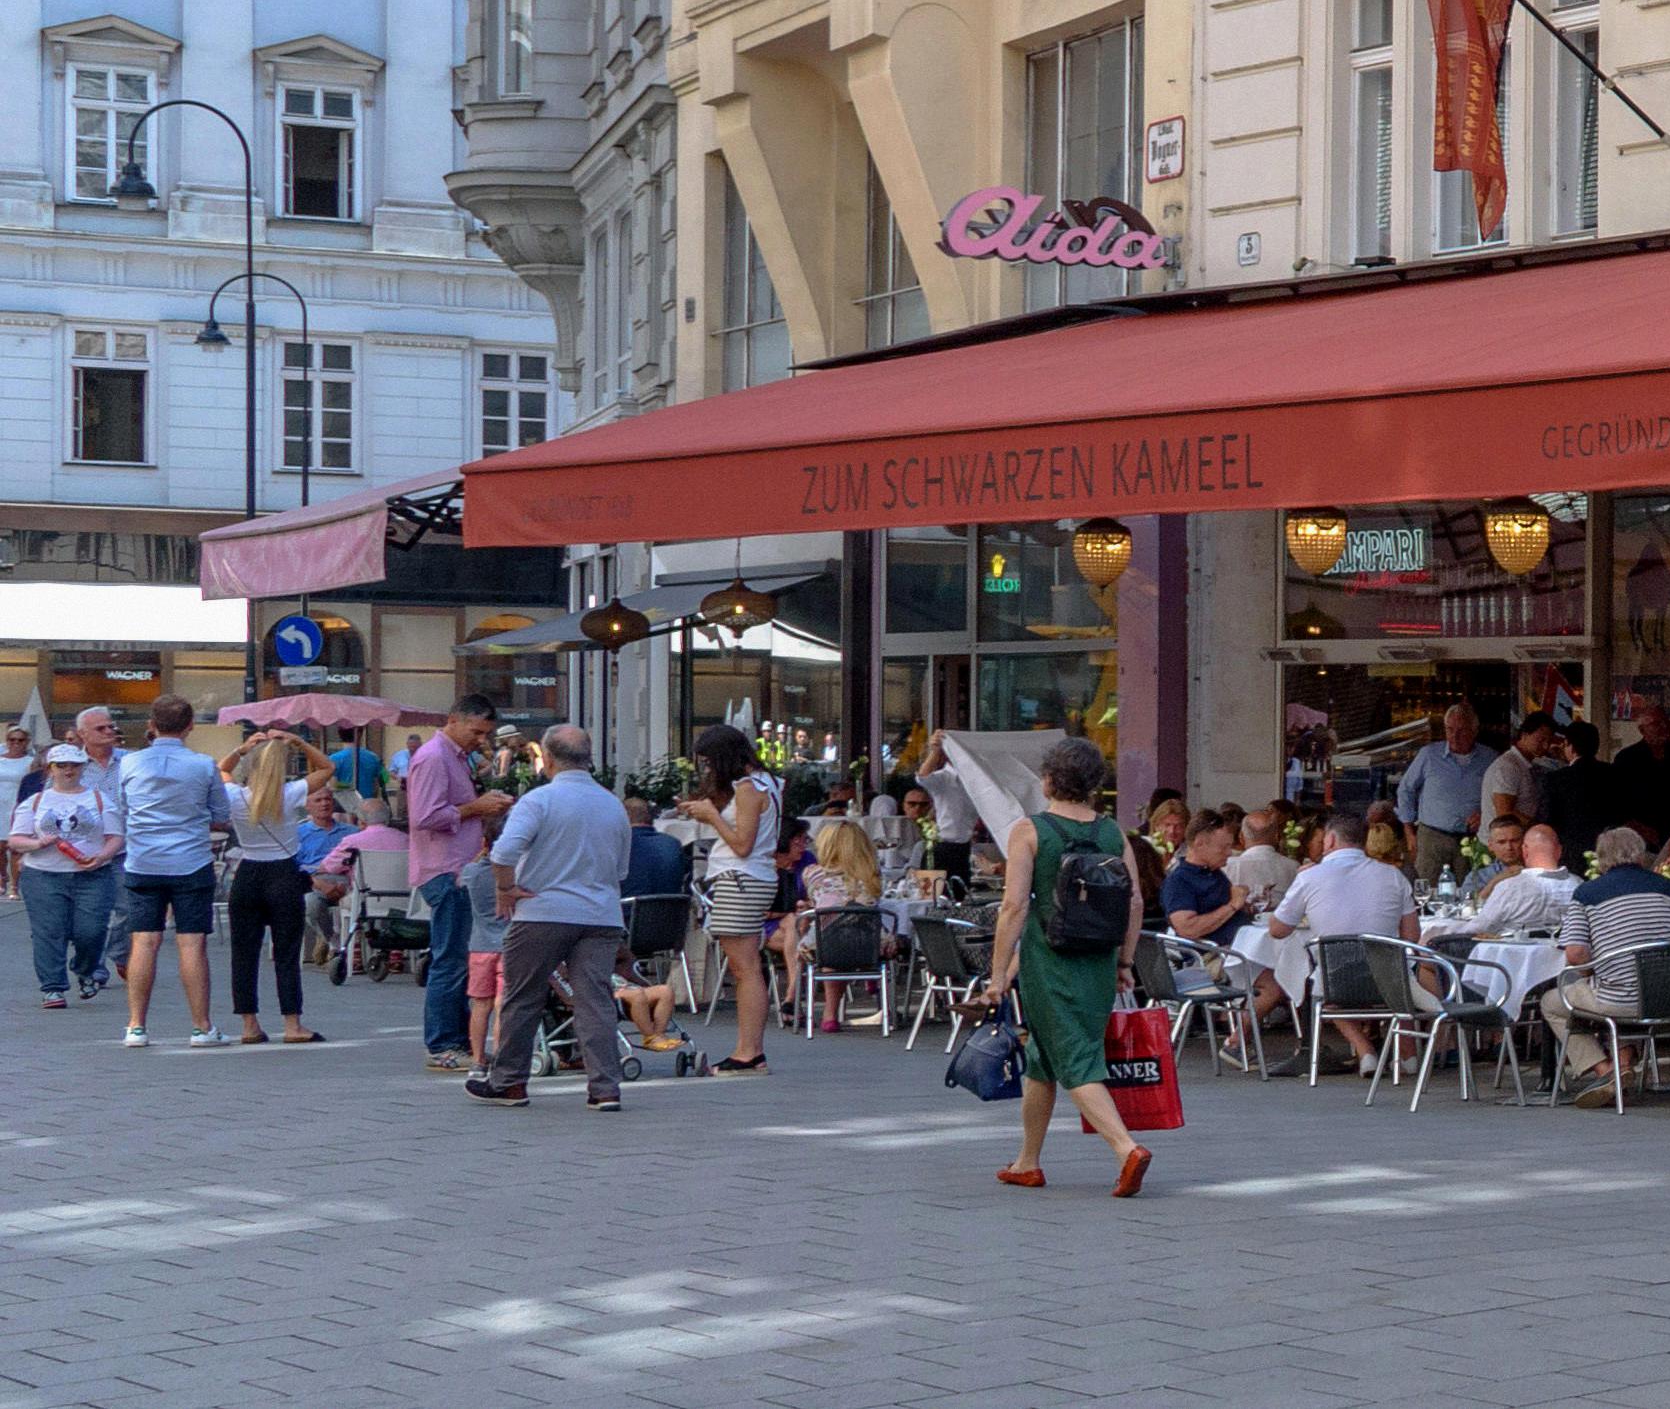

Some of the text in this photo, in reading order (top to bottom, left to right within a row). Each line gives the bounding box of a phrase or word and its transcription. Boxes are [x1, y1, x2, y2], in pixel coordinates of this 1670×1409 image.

[944, 185, 1168, 271] Aida
[800, 432, 1263, 515] ZUM SCHWARZEN KAMEEL
[1323, 528, 1424, 576] AMPARI
[105, 670, 153, 681] WAGNER
[327, 674, 361, 684] AGNER
[513, 676, 557, 687] WAGNER
